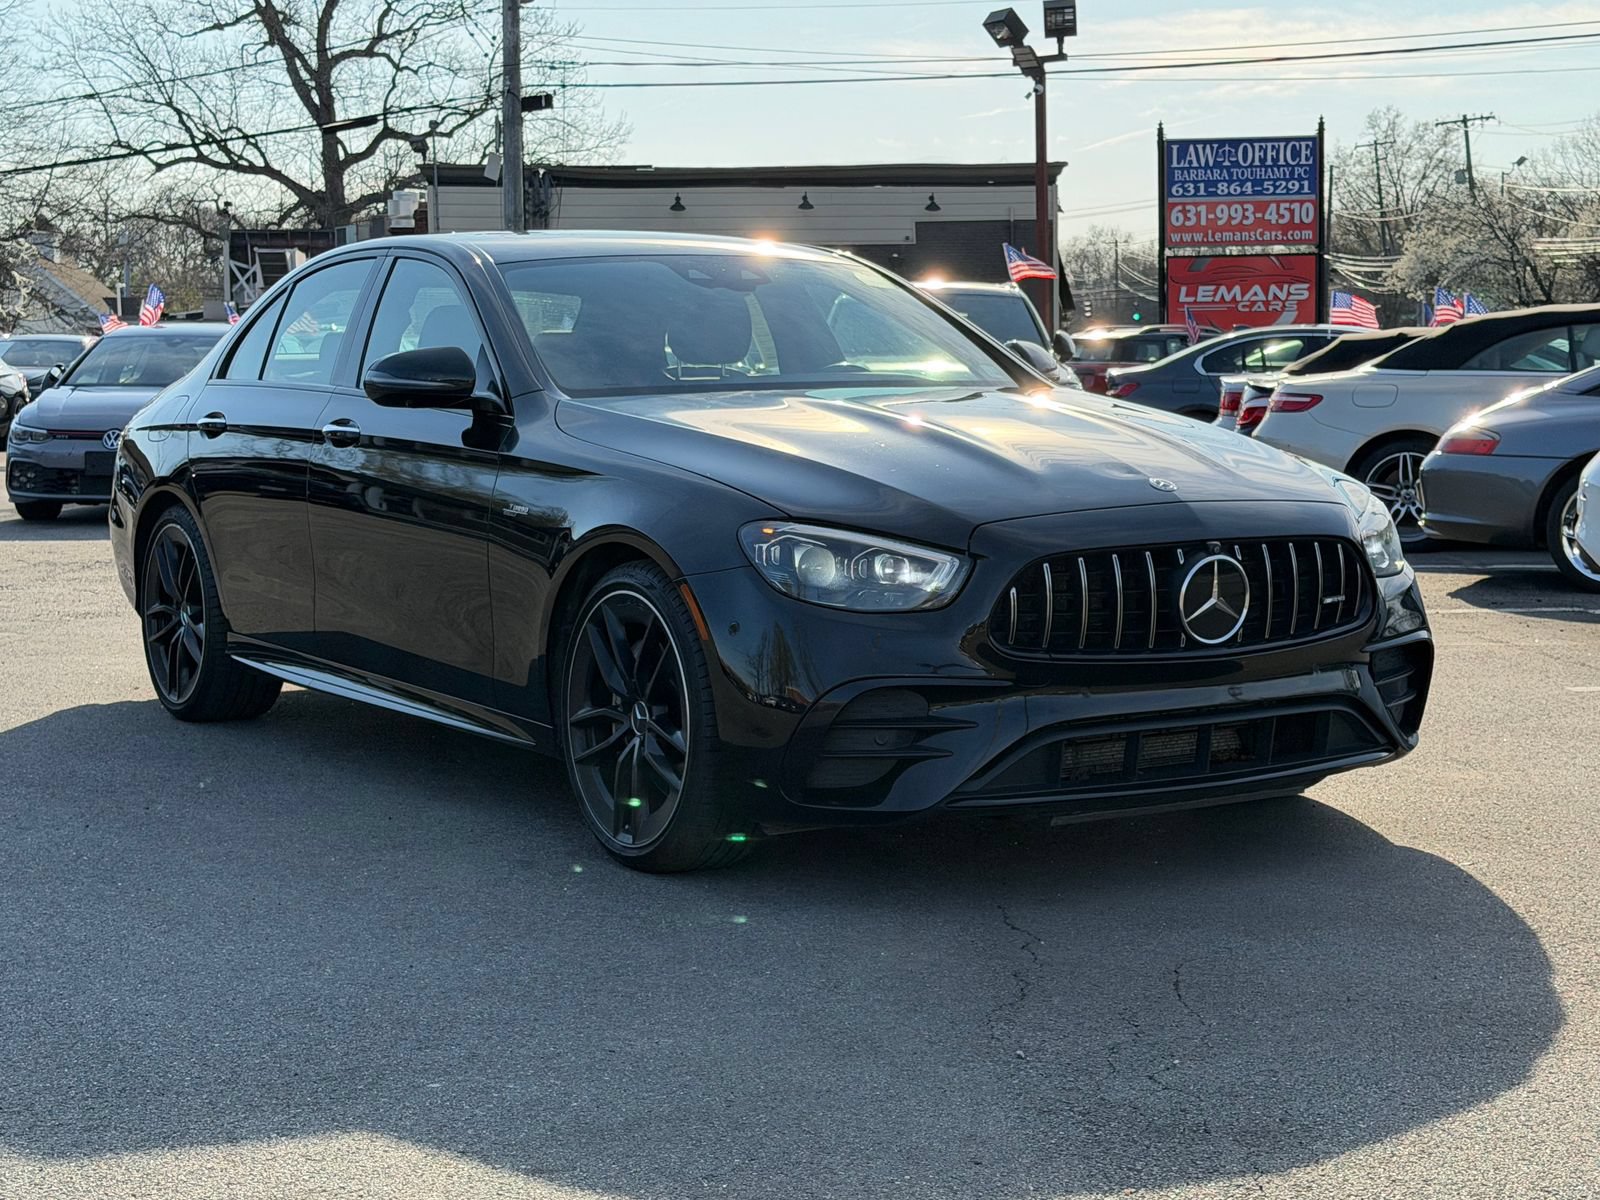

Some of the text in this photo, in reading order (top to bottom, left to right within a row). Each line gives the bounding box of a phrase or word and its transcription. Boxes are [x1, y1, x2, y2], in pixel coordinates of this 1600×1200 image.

[1171, 141, 1313, 167] LAW OFFICE
[1174, 166, 1309, 181] BARBARA TOUHAMY PC
[1171, 181, 1310, 196] 631-864-5291
[1170, 203, 1314, 226] 631-993-4510
[1171, 229, 1313, 242] www.LemansCars.com
[1179, 284, 1310, 302] LEMANS
[1237, 301, 1299, 312] CARS
